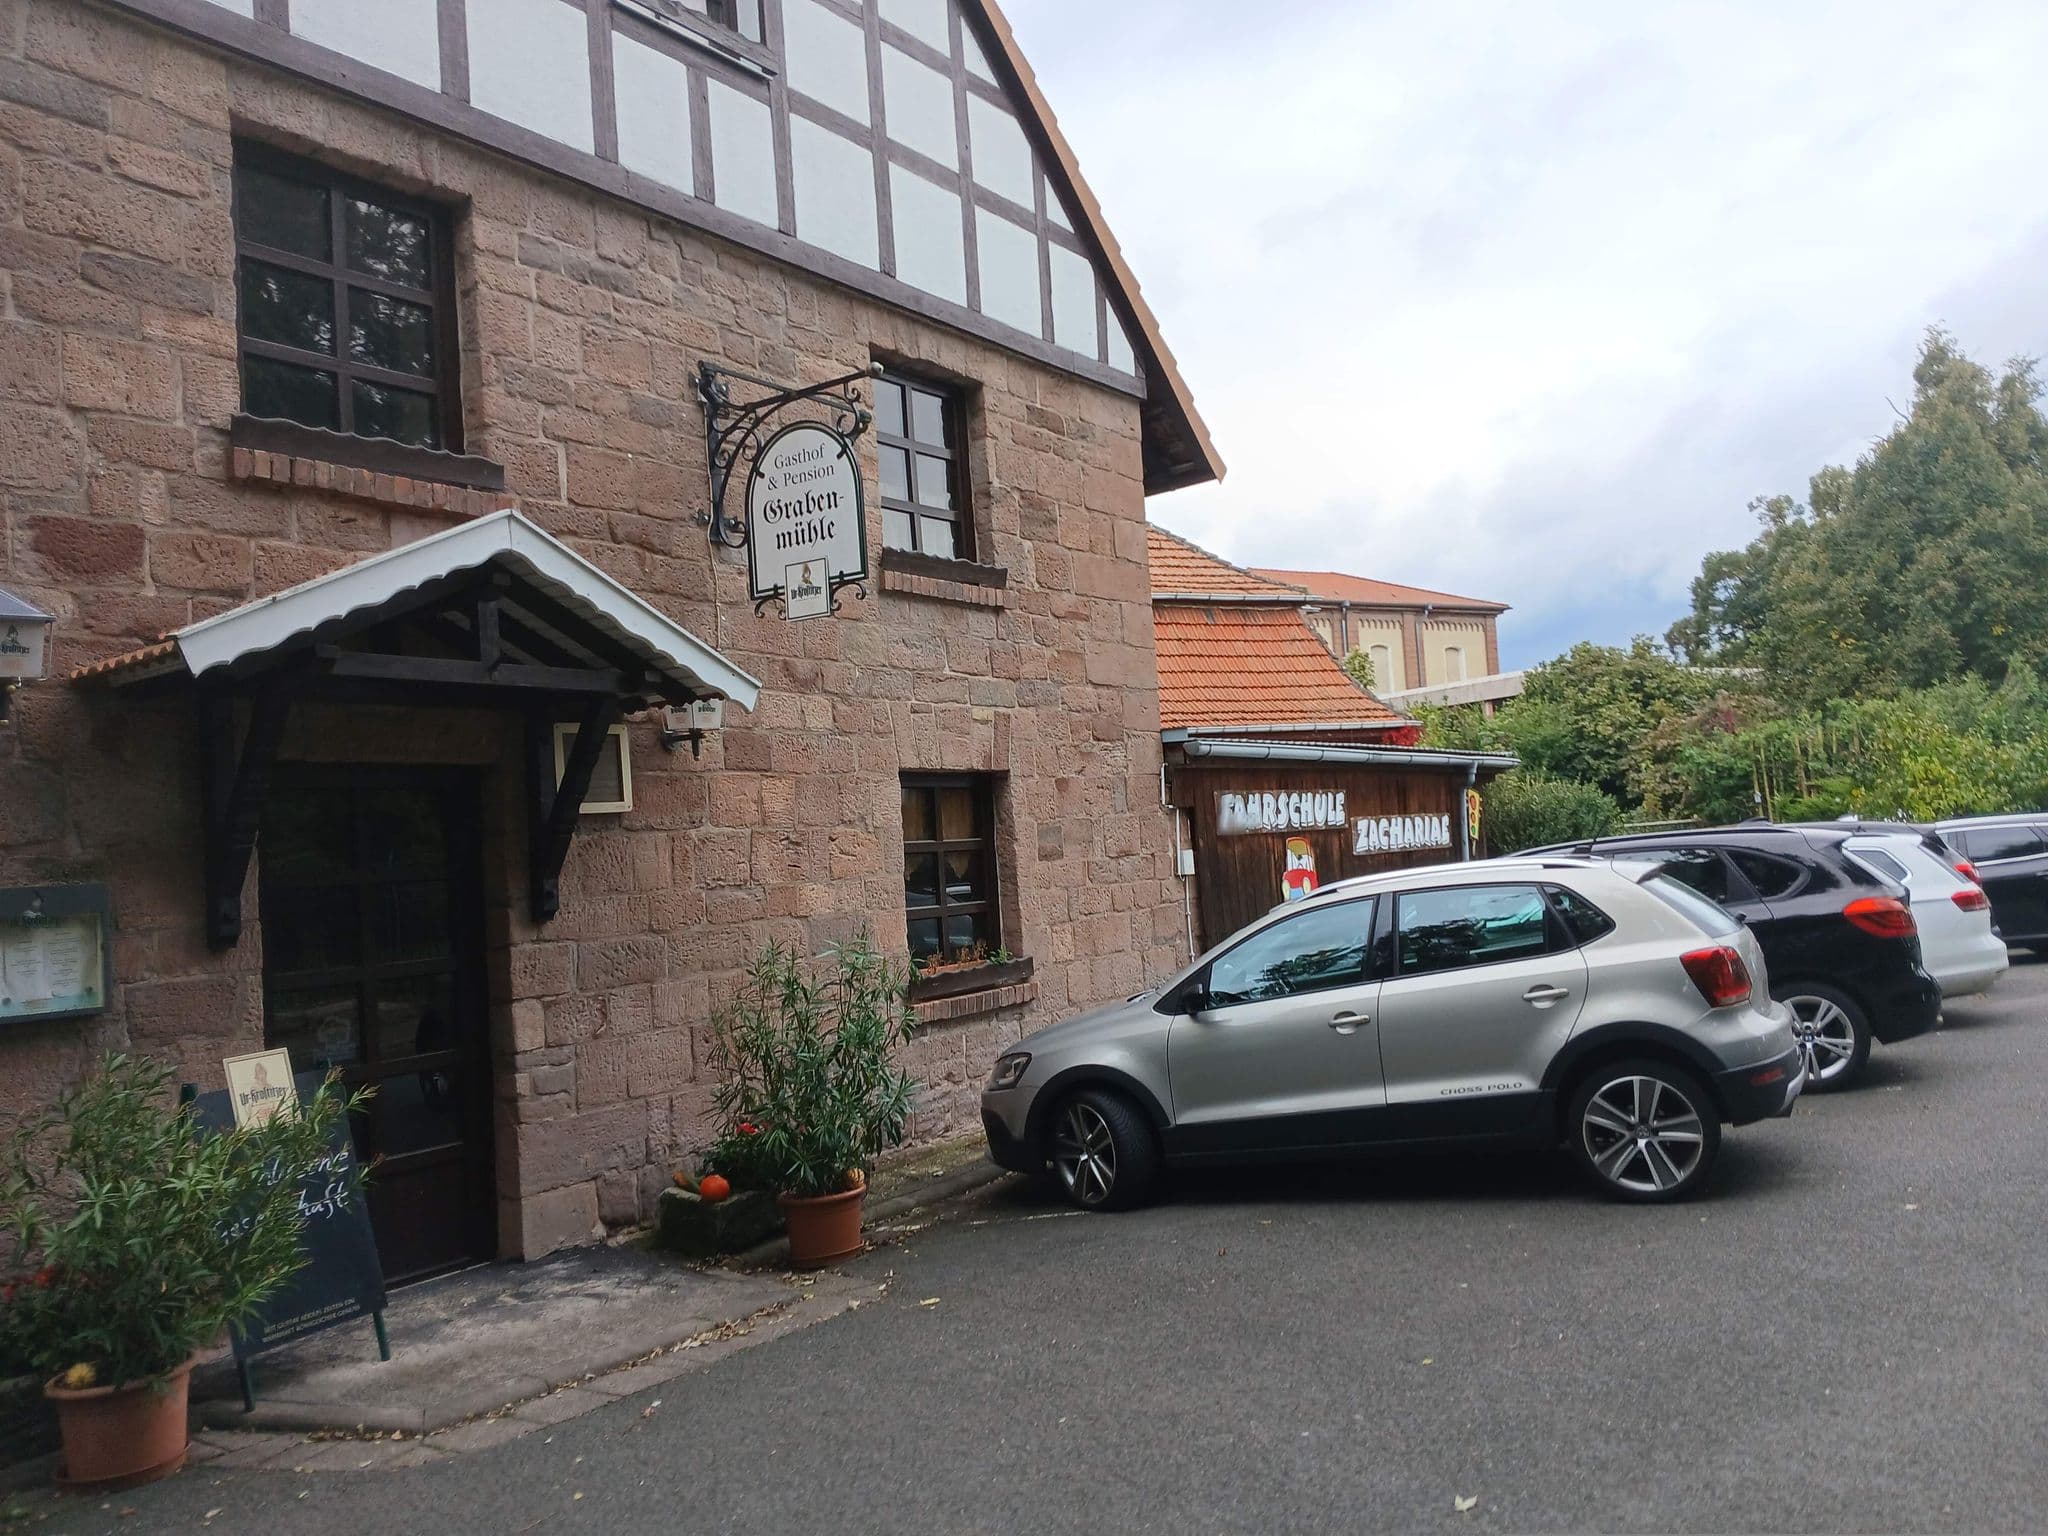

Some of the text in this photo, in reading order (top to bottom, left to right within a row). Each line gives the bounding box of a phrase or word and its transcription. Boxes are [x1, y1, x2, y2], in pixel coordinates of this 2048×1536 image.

[774, 443, 826, 470] Gasthof
[767, 467, 835, 491] & Pension
[763, 489, 845, 525] Graben-
[775, 516, 837, 551] mühle
[1219, 791, 1346, 830] FAHRSCHULE
[1440, 1081, 1523, 1096] CROSS POLO
